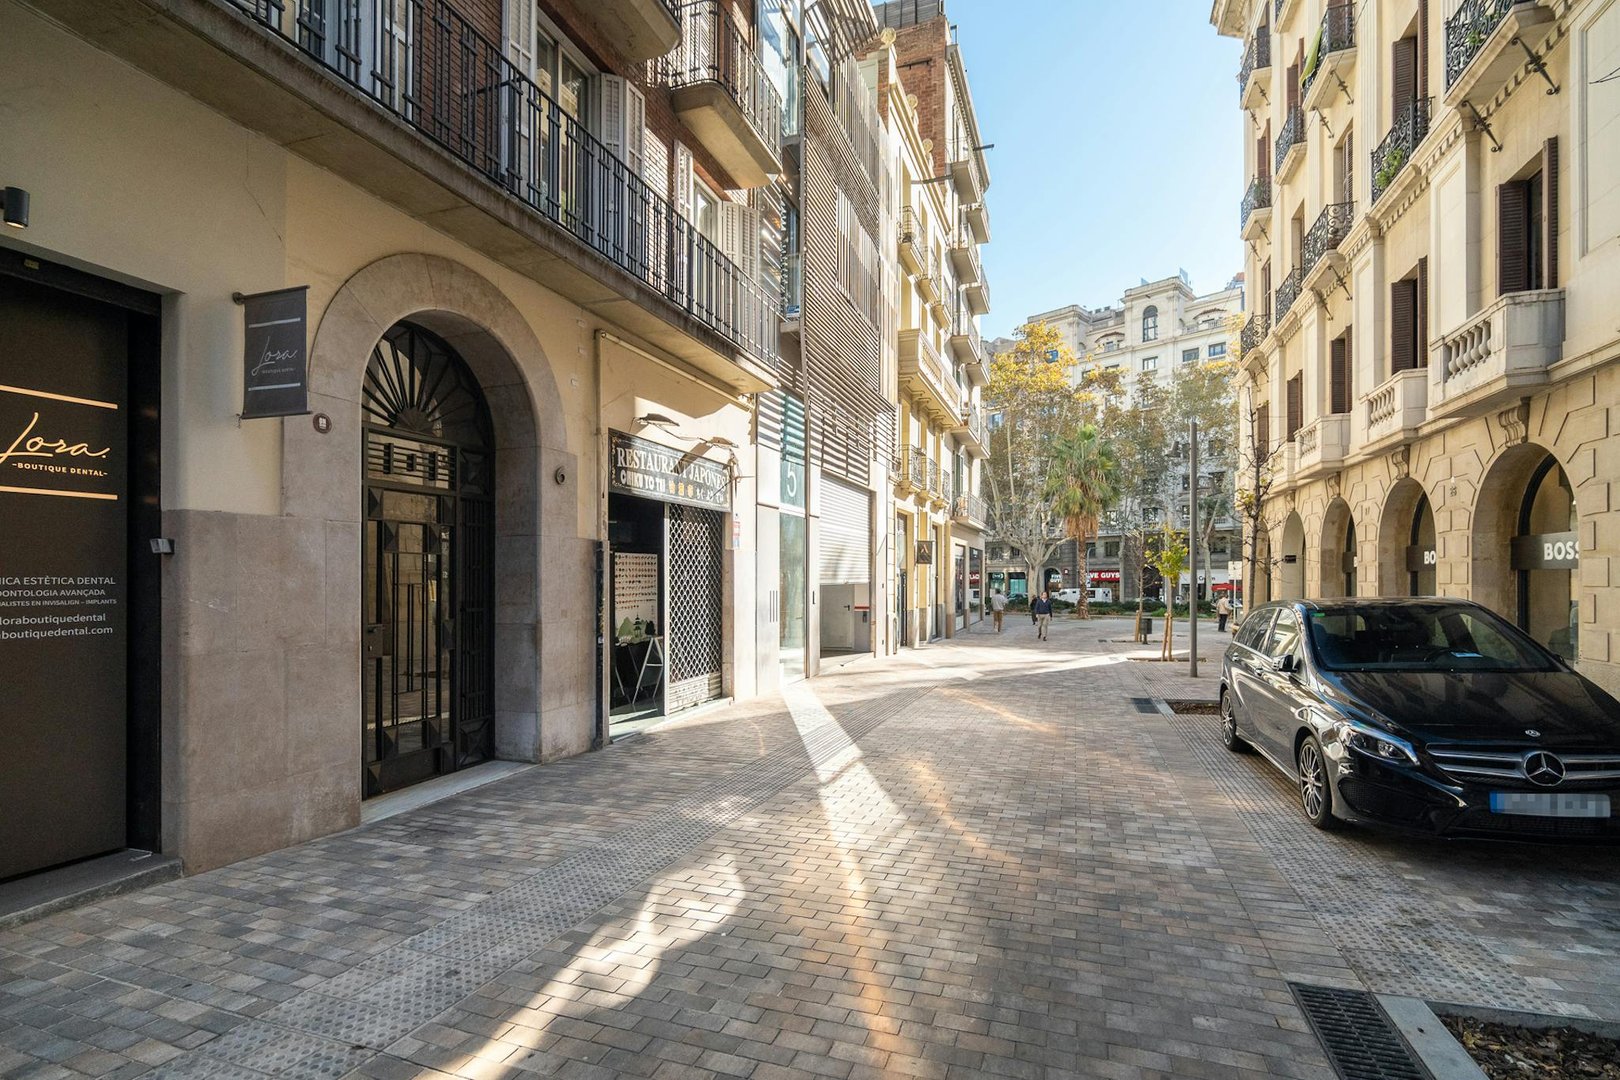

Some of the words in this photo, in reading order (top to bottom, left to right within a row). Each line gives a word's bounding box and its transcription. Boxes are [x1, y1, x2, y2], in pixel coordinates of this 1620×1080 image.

[0, 576, 21, 586] ICA
[23, 575, 75, 586] ESTÈTICA
[77, 576, 116, 586] DENTAL
[59, 588, 106, 598] AVANÇADA
[0, 626, 113, 640] boutiquedental.com
